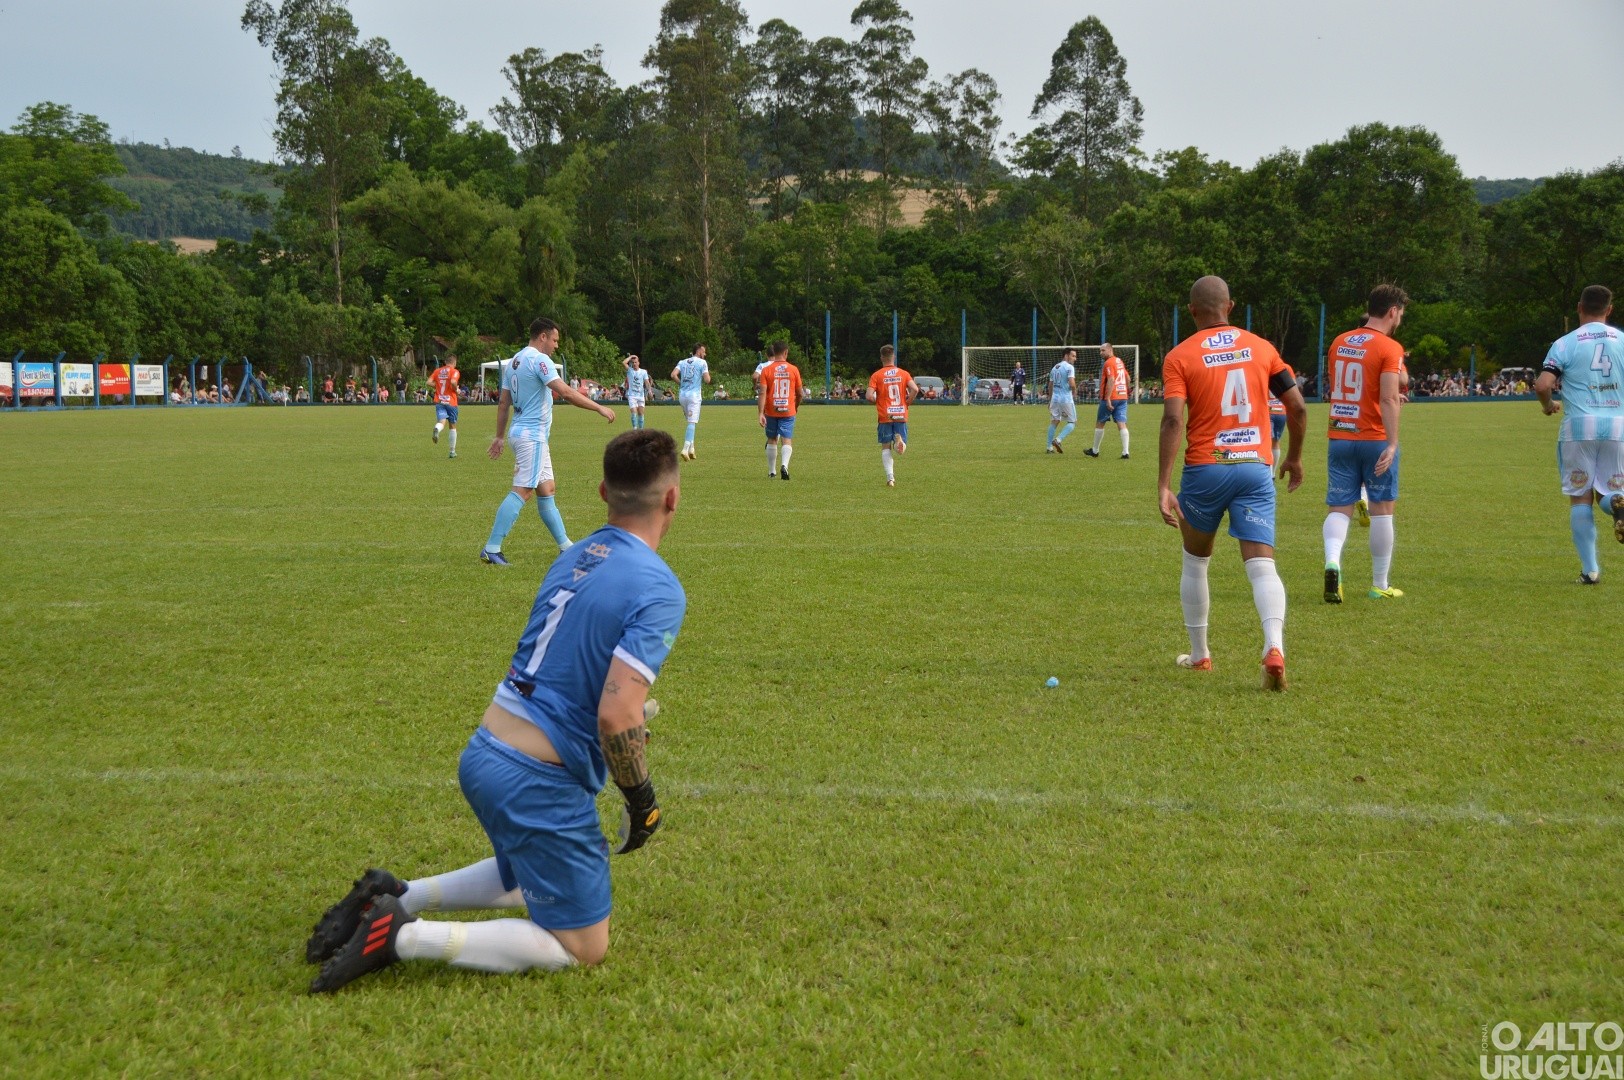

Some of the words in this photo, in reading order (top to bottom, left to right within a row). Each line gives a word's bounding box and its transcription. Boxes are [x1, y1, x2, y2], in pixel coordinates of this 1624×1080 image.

[1208, 333, 1233, 347] LJB
[1204, 350, 1250, 364] DREBOR
[1590, 343, 1612, 377] 4
[440, 379, 447, 395] 7
[1115, 369, 1126, 385] 20
[1331, 360, 1363, 402] 19
[511, 374, 518, 403] 9
[773, 379, 790, 399] 18
[888, 384, 901, 406] 9
[1221, 368, 1252, 423] 4
[1245, 516, 1269, 525] IDEAL
[522, 586, 577, 677] 1
